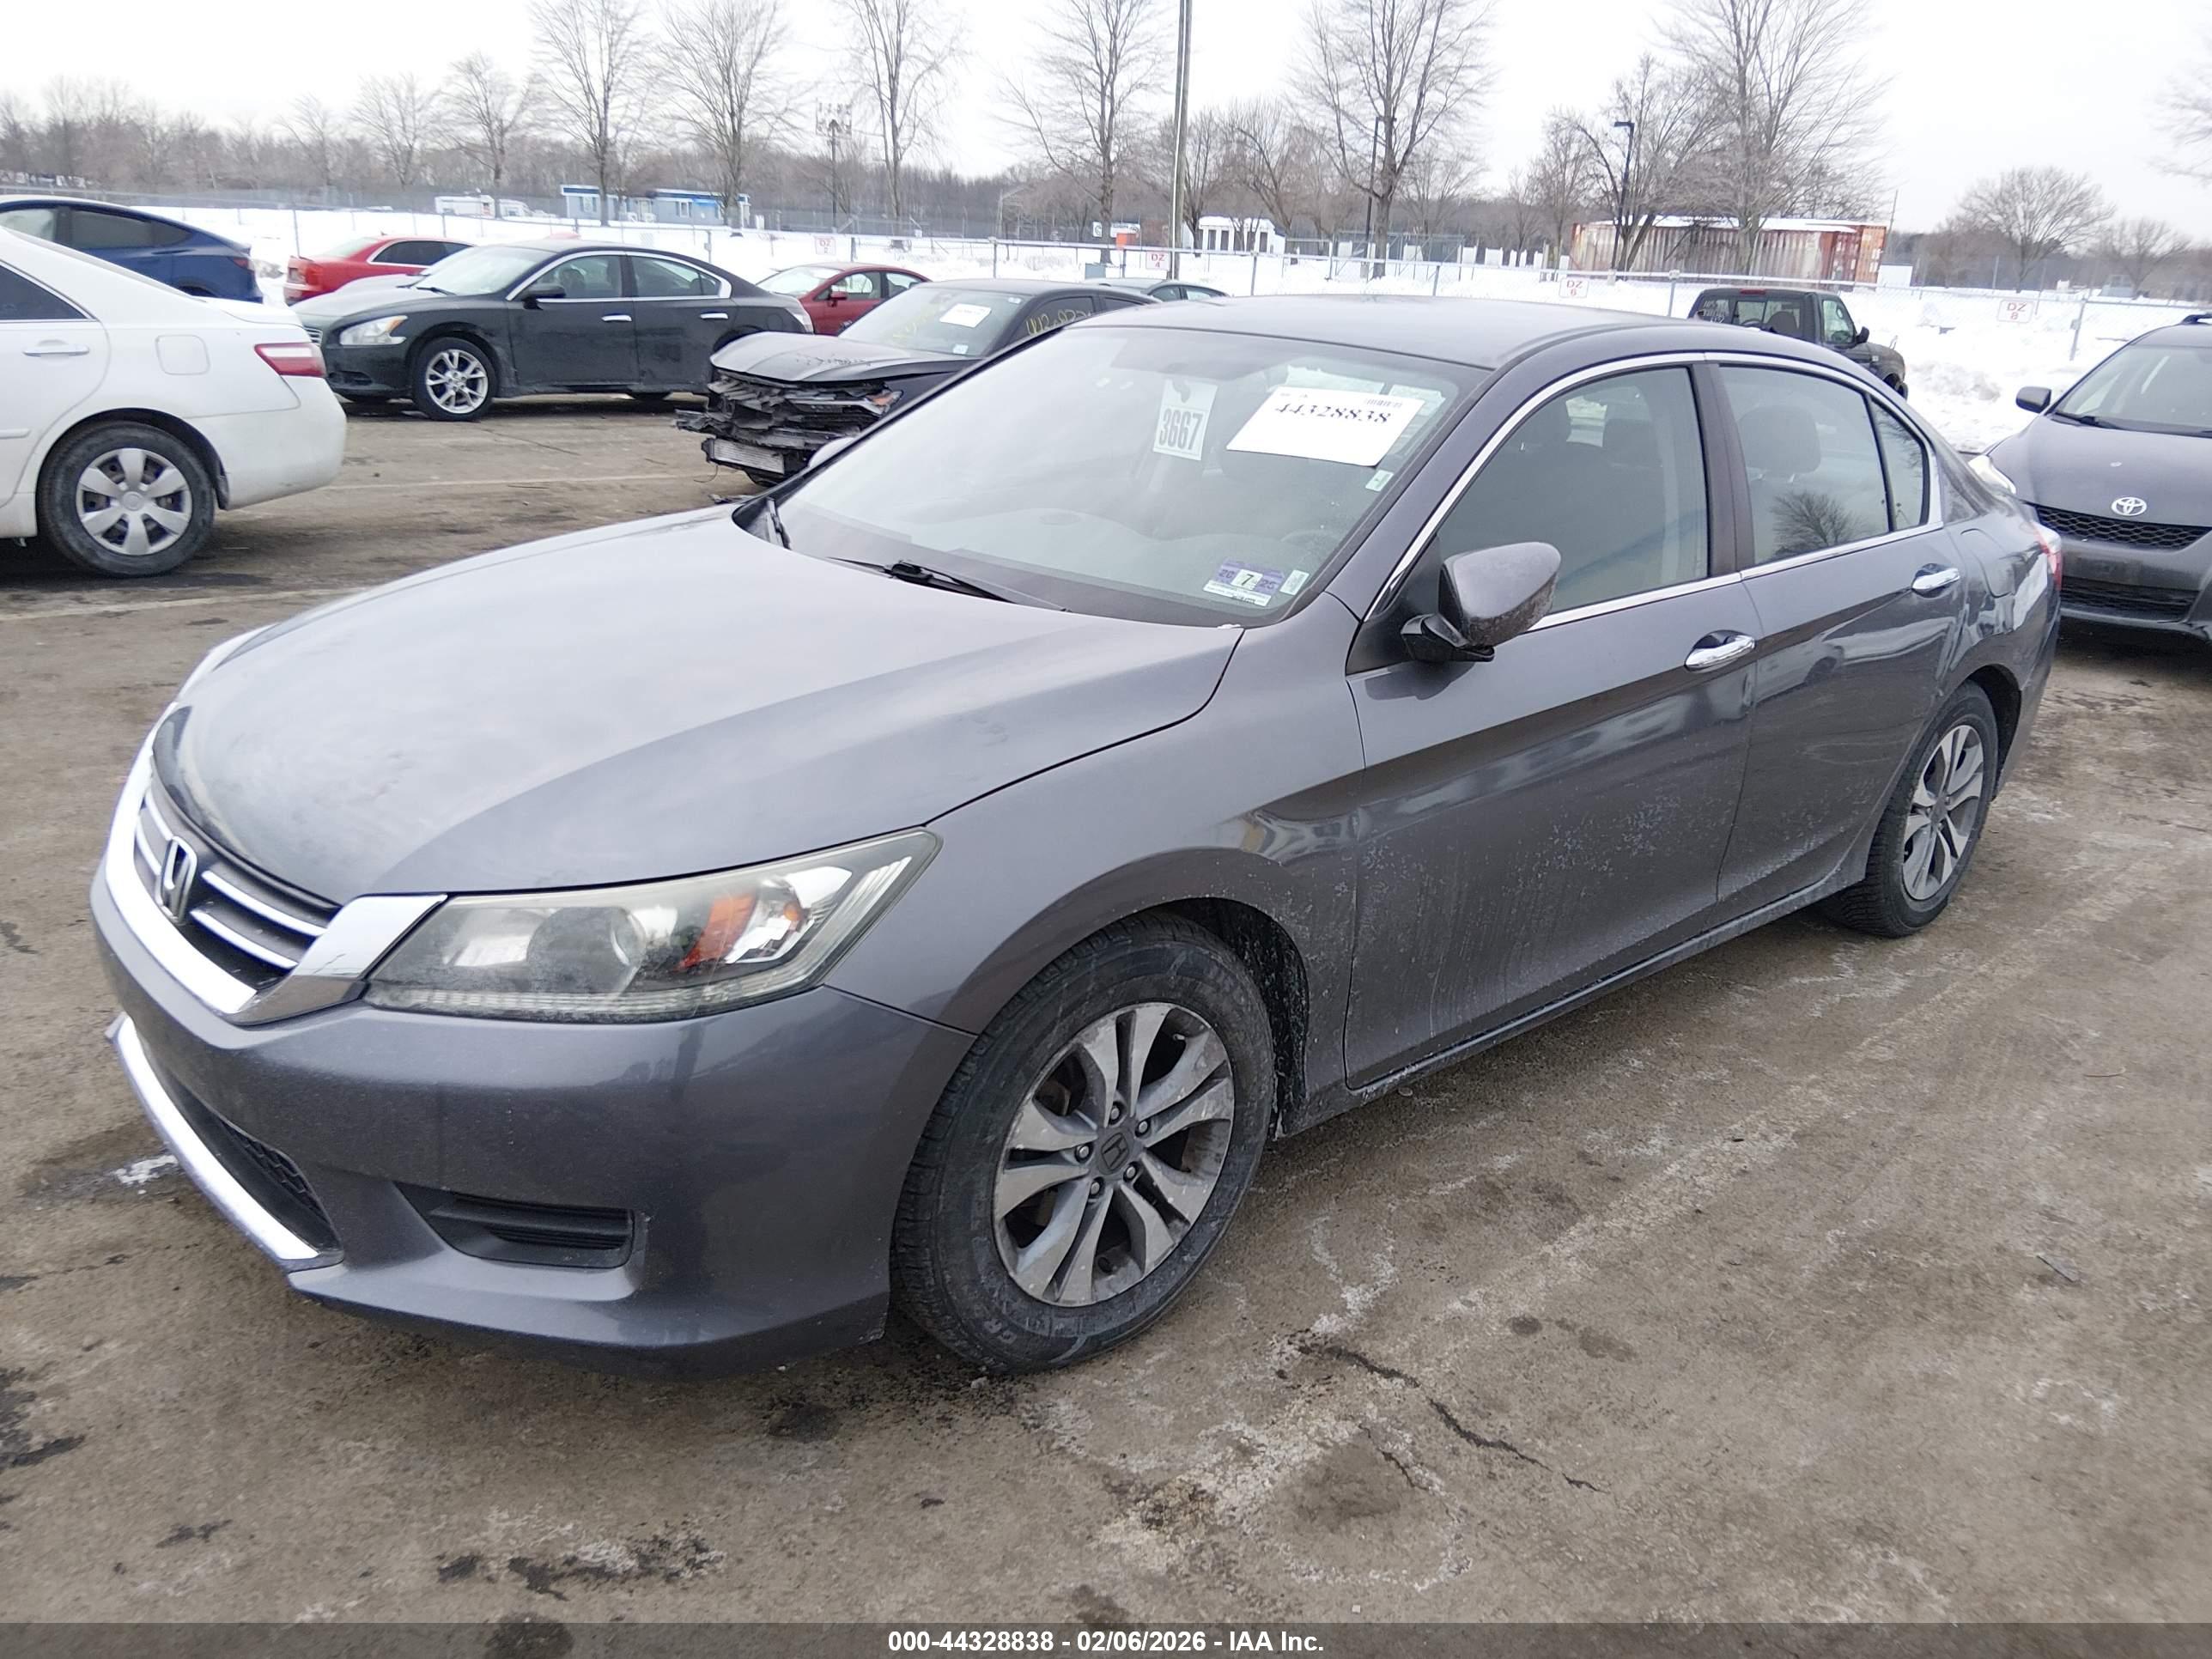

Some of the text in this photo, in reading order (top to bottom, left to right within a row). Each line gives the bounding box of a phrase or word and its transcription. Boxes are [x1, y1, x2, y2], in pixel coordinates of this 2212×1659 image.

[1151, 253, 1165, 262] DZ
[1566, 280, 1583, 289] DZ
[2007, 302, 2027, 312] DZ
[2010, 312, 2019, 320] 8
[1275, 404, 1391, 423] 44328838
[1158, 408, 1203, 450] 3667
[1241, 573, 1255, 586] 7
